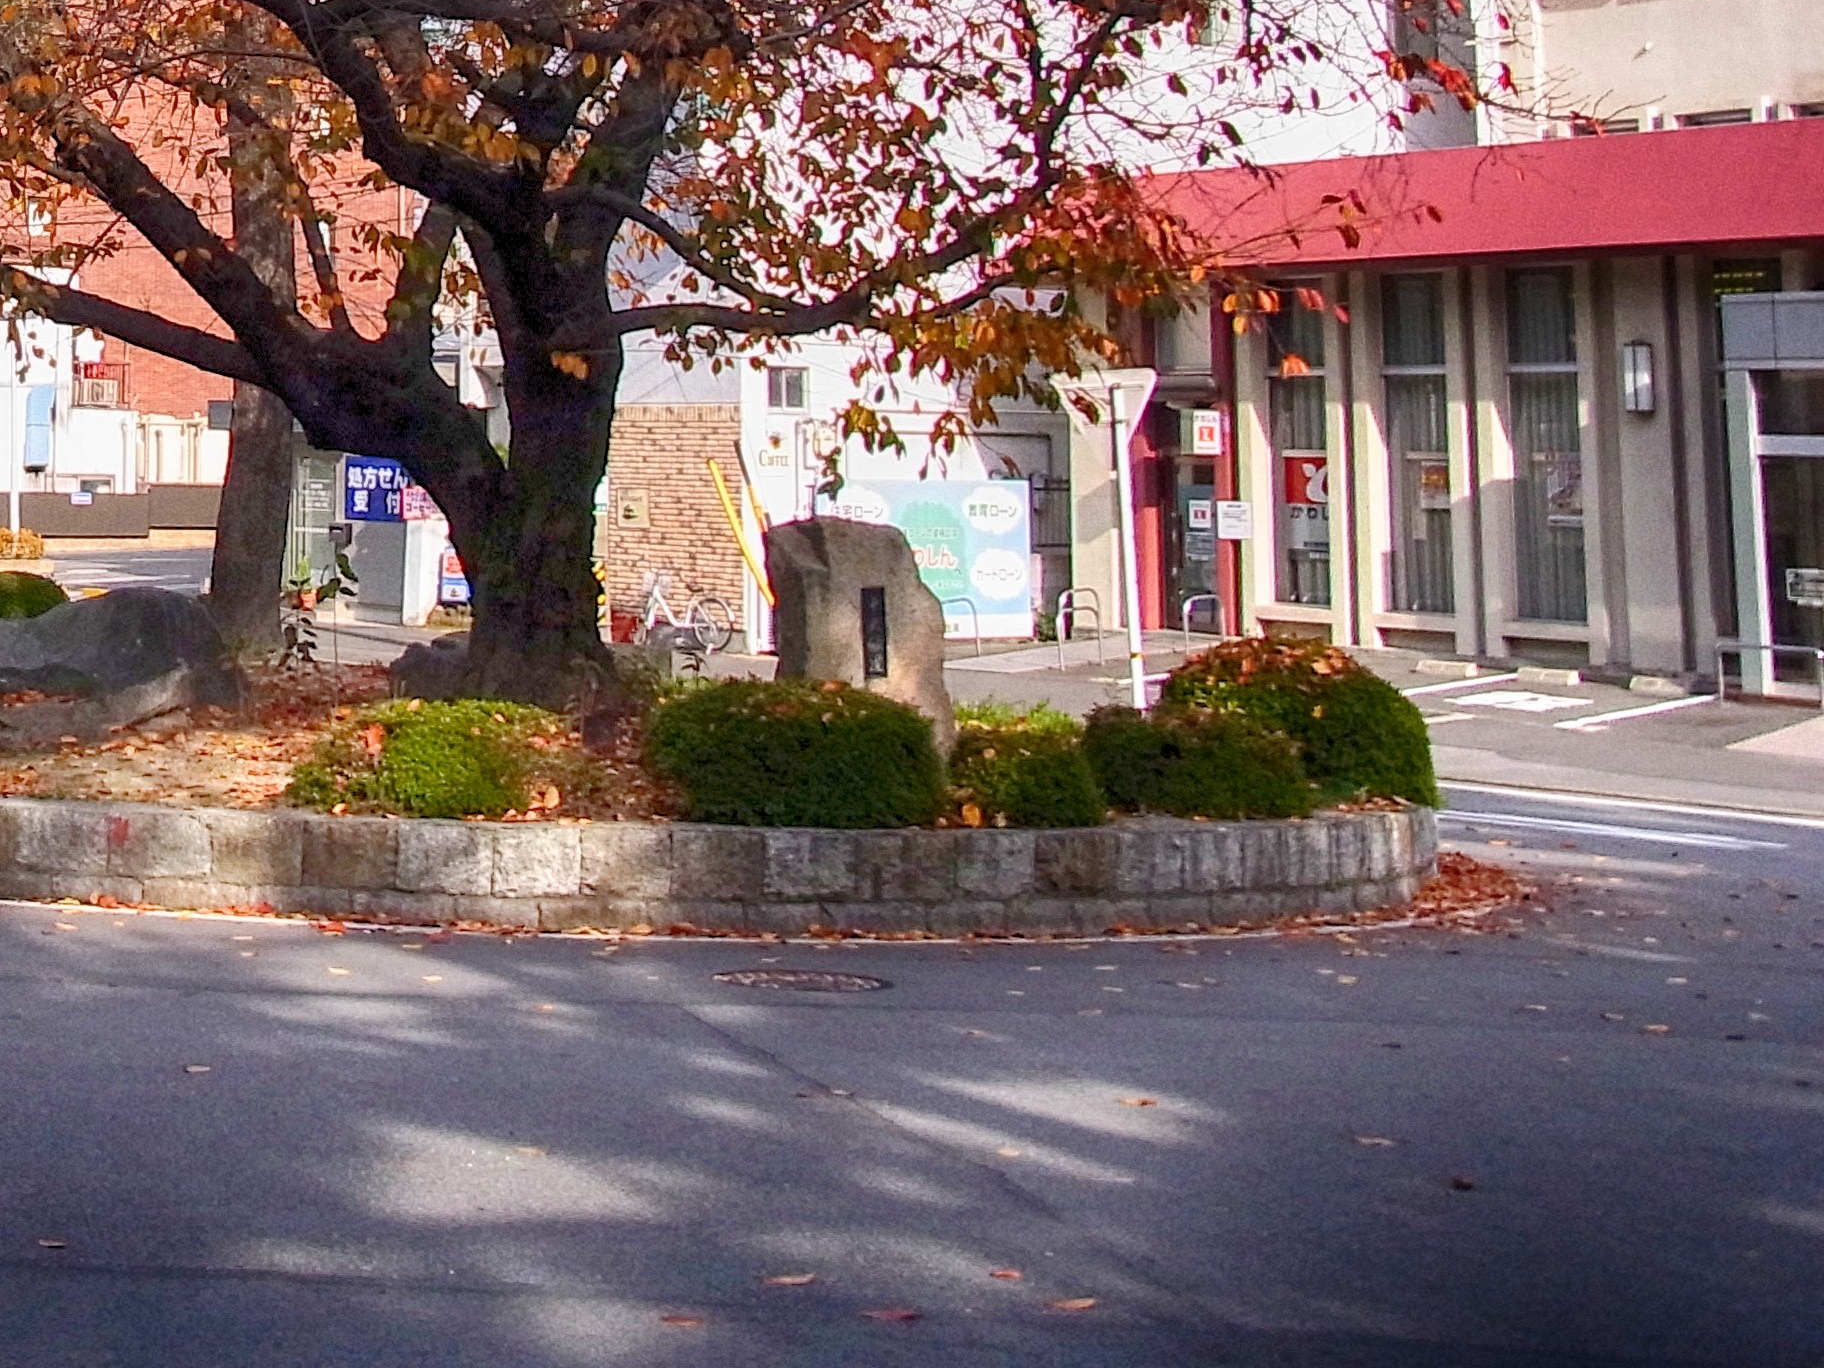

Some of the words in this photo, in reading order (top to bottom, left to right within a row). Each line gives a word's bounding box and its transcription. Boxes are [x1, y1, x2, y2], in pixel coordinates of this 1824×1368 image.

[348, 466, 409, 490] 処方せん
[353, 490, 401, 515] 受付
